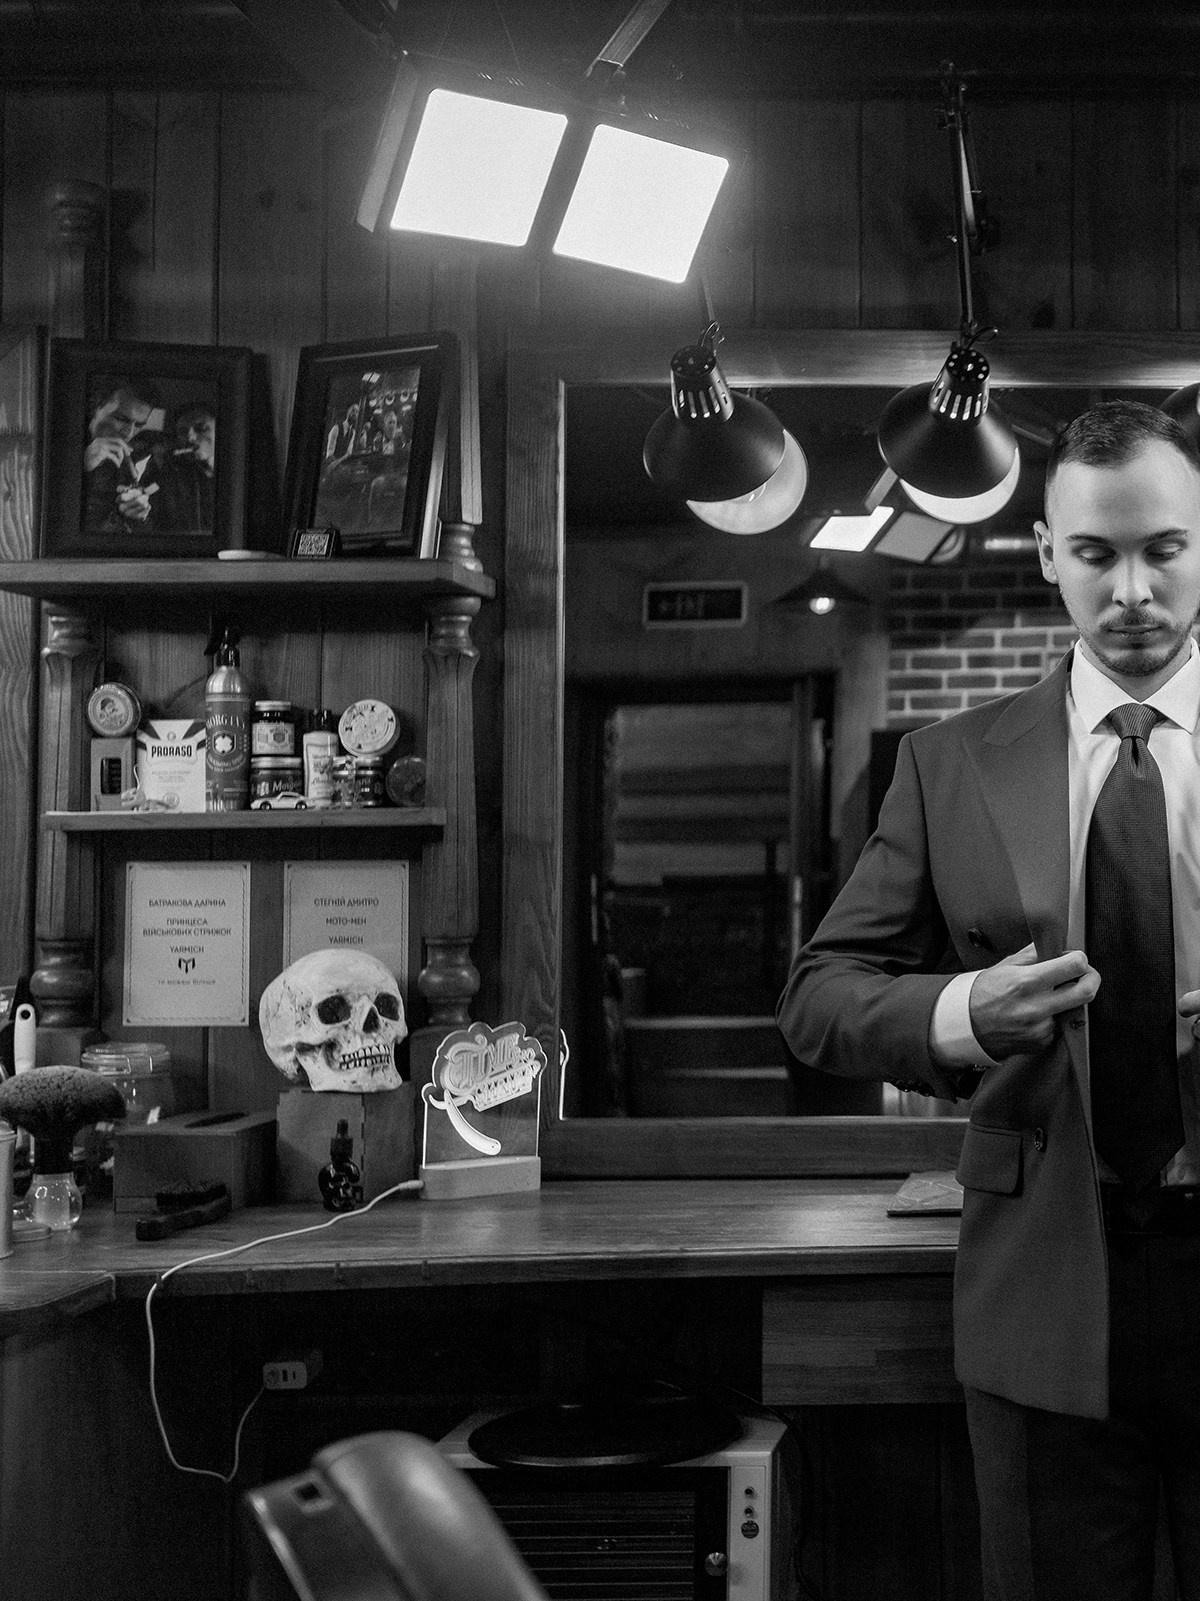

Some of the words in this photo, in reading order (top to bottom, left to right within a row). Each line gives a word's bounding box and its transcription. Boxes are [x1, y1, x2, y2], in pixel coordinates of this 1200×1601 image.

[151, 745, 193, 758] PRORASO
[148, 899, 193, 907] БАТРАКОВА
[194, 899, 226, 908] ДАРИНА
[166, 917, 208, 926] ПРИНЦЕСА
[328, 935, 364, 945] YARMICH
[170, 945, 205, 953] YARMICH
